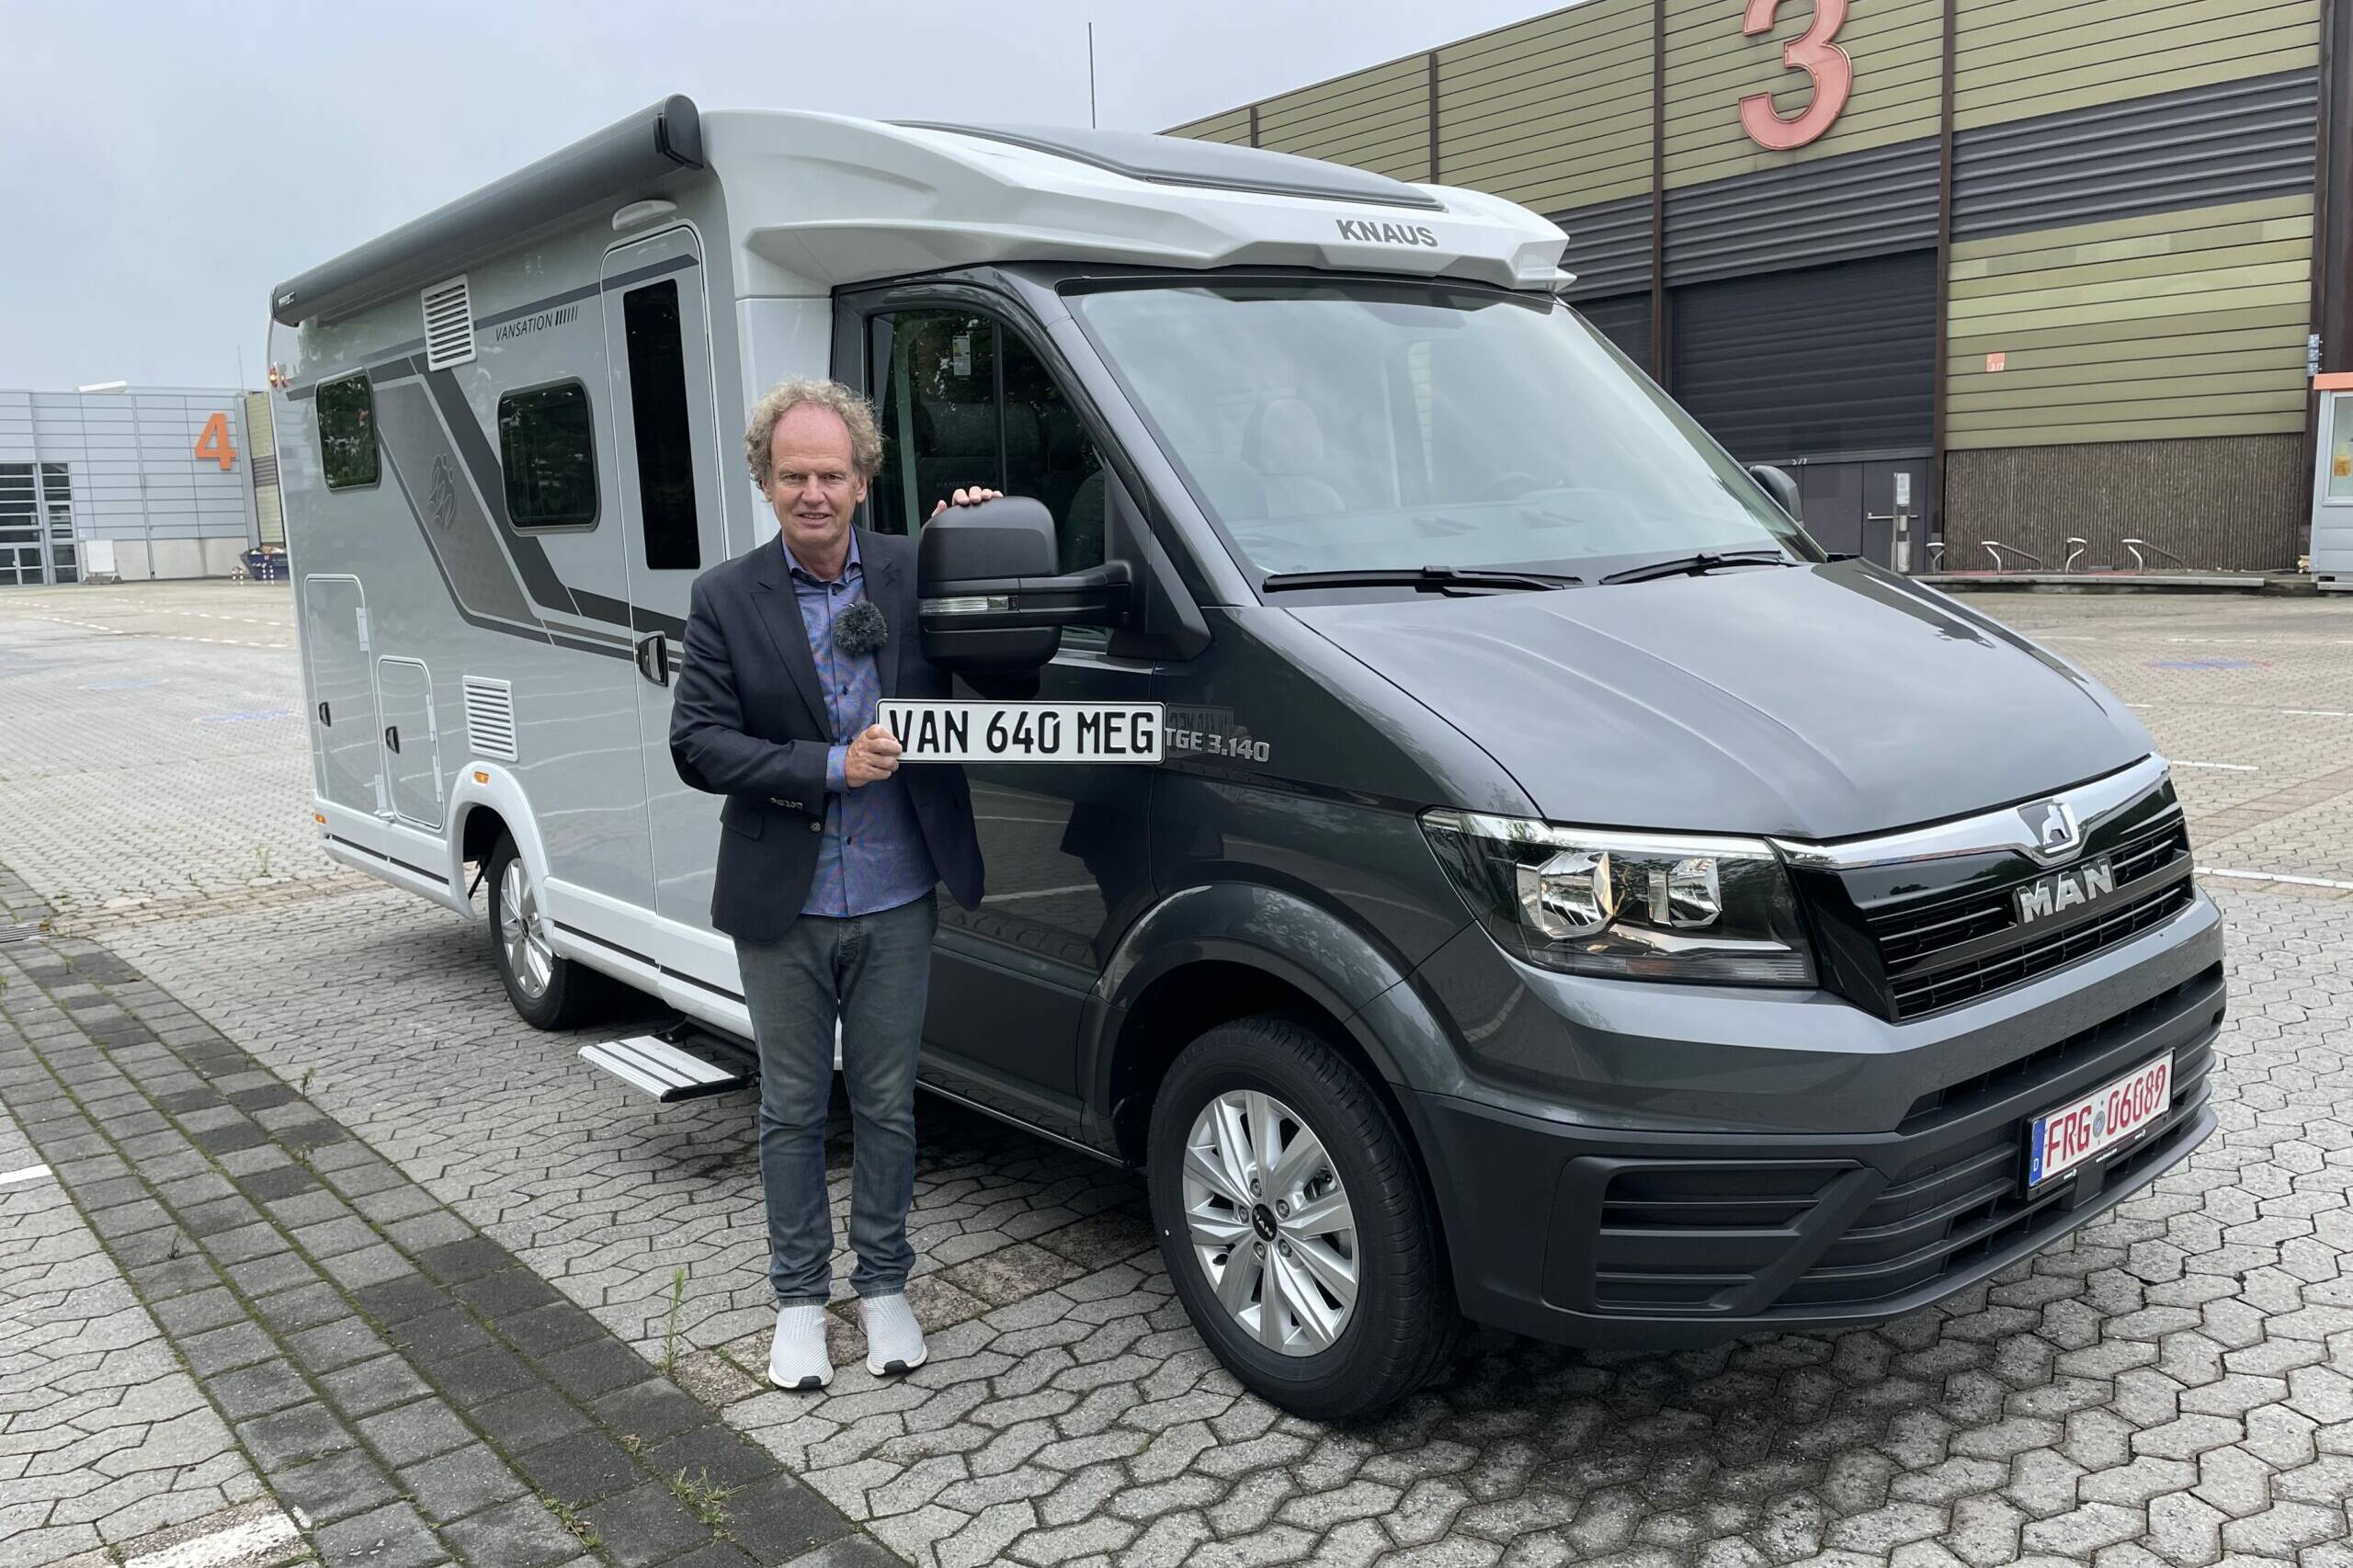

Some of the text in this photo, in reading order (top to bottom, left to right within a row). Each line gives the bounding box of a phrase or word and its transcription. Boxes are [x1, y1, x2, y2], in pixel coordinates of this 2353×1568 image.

[1739, 0, 1853, 150] 3
[1336, 219, 1438, 247] KNAUS
[495, 312, 553, 342] VANSATION
[194, 413, 237, 471] 4
[890, 710, 969, 754] VAN
[986, 710, 1061, 754] 640
[1077, 711, 1154, 755] MEG
[1165, 727, 1270, 762] TGE 3.140
[2017, 858, 2113, 923] MAN
[2046, 1064, 2166, 1168] FRG 06089
[2033, 1158, 2040, 1172] D
